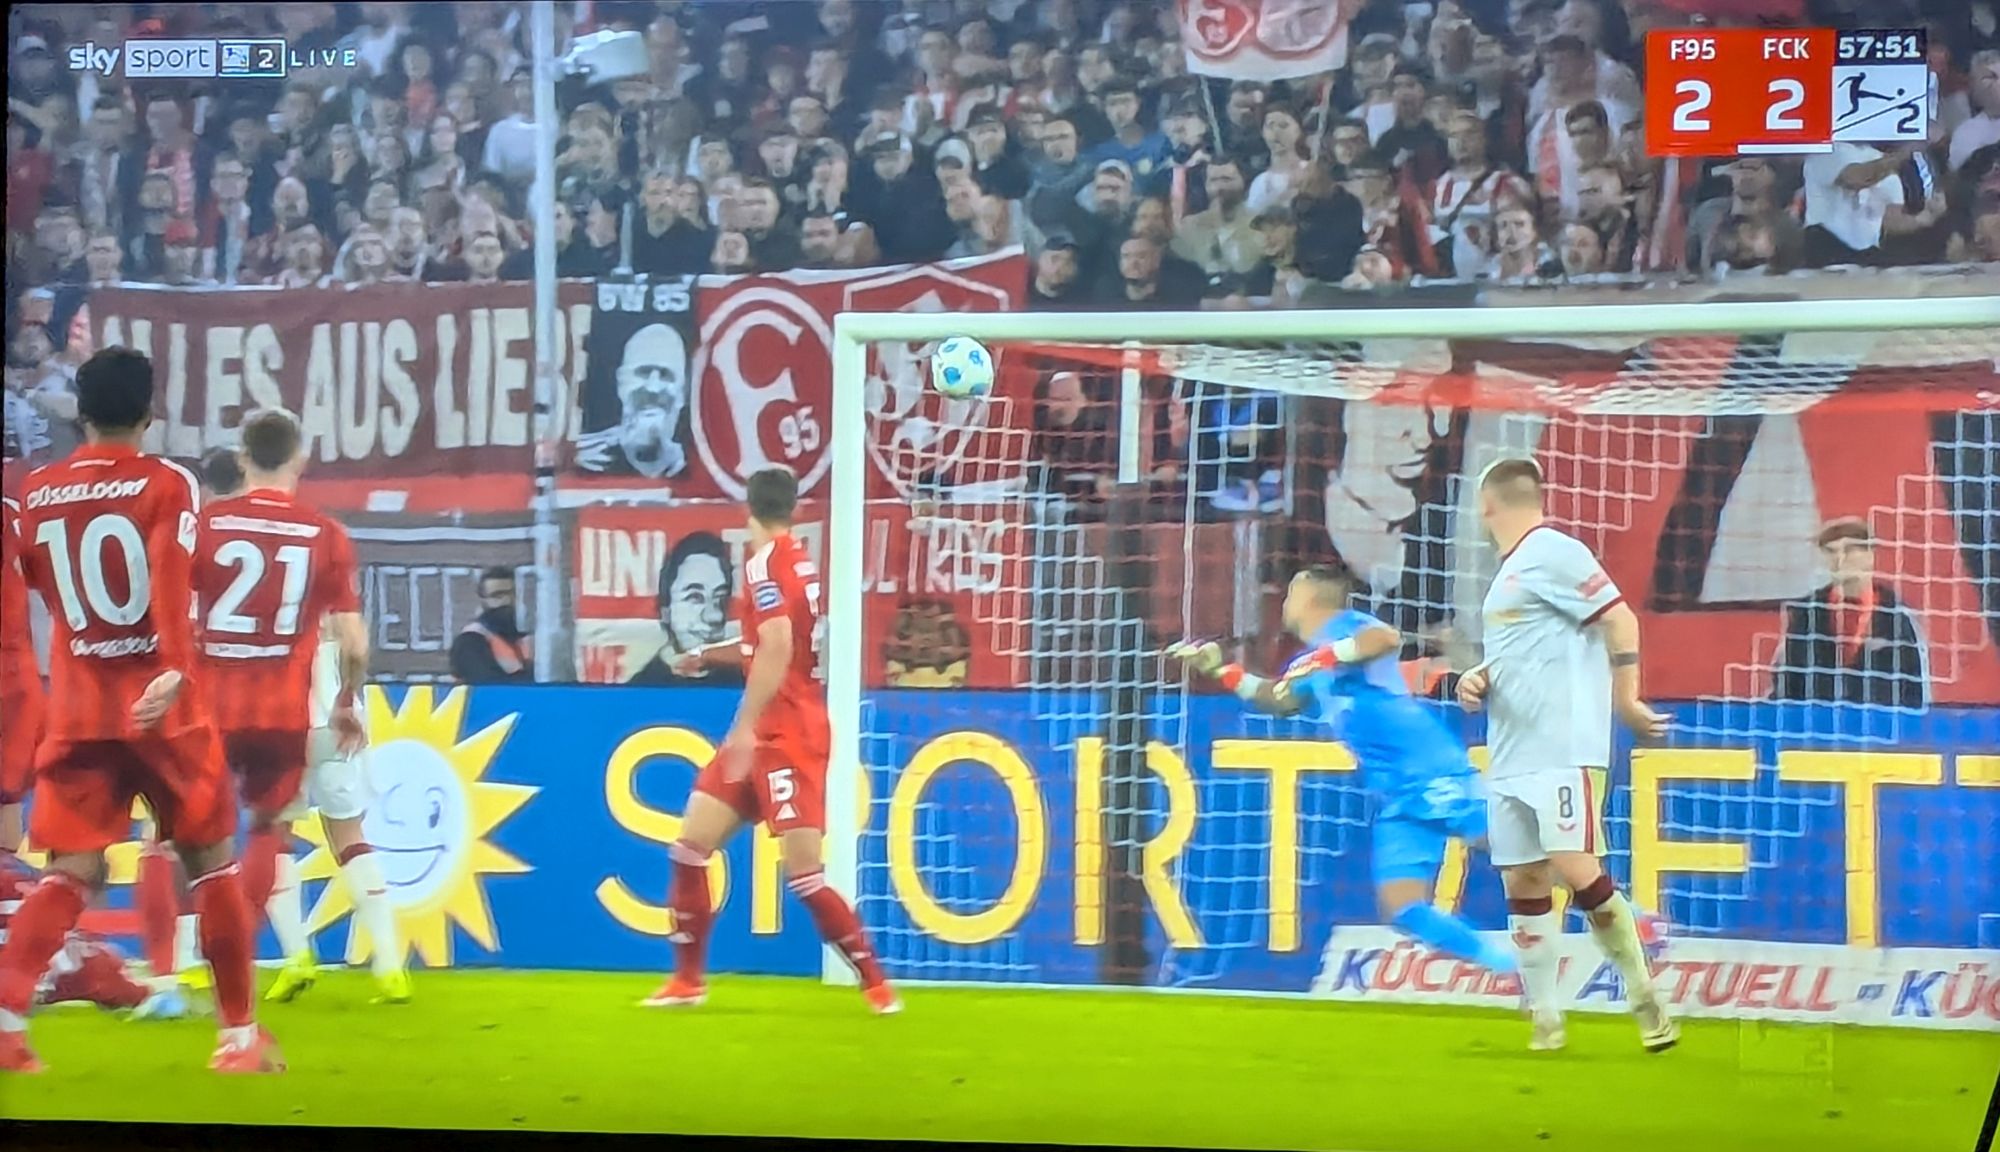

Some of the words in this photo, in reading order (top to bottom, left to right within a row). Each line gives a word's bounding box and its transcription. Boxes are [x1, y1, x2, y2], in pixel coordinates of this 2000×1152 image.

[69, 43, 120, 75] sky
[131, 46, 210, 73] sport
[257, 49, 275, 69] 2
[290, 50, 357, 67] LIVE
[1671, 38, 1716, 61] F95
[1763, 38, 1810, 60] FCK
[1839, 35, 1921, 59] 57:51
[1673, 79, 1712, 132] 2
[1766, 78, 1805, 131] 2
[1896, 102, 1921, 134] 2
[102, 315, 285, 458] LLES
[300, 320, 421, 463] AUS
[778, 404, 821, 460] 95
[35, 513, 151, 632] 10
[206, 540, 311, 635] 21
[1557, 785, 1574, 819] 8
[1576, 958, 1837, 1011] ATUELL
